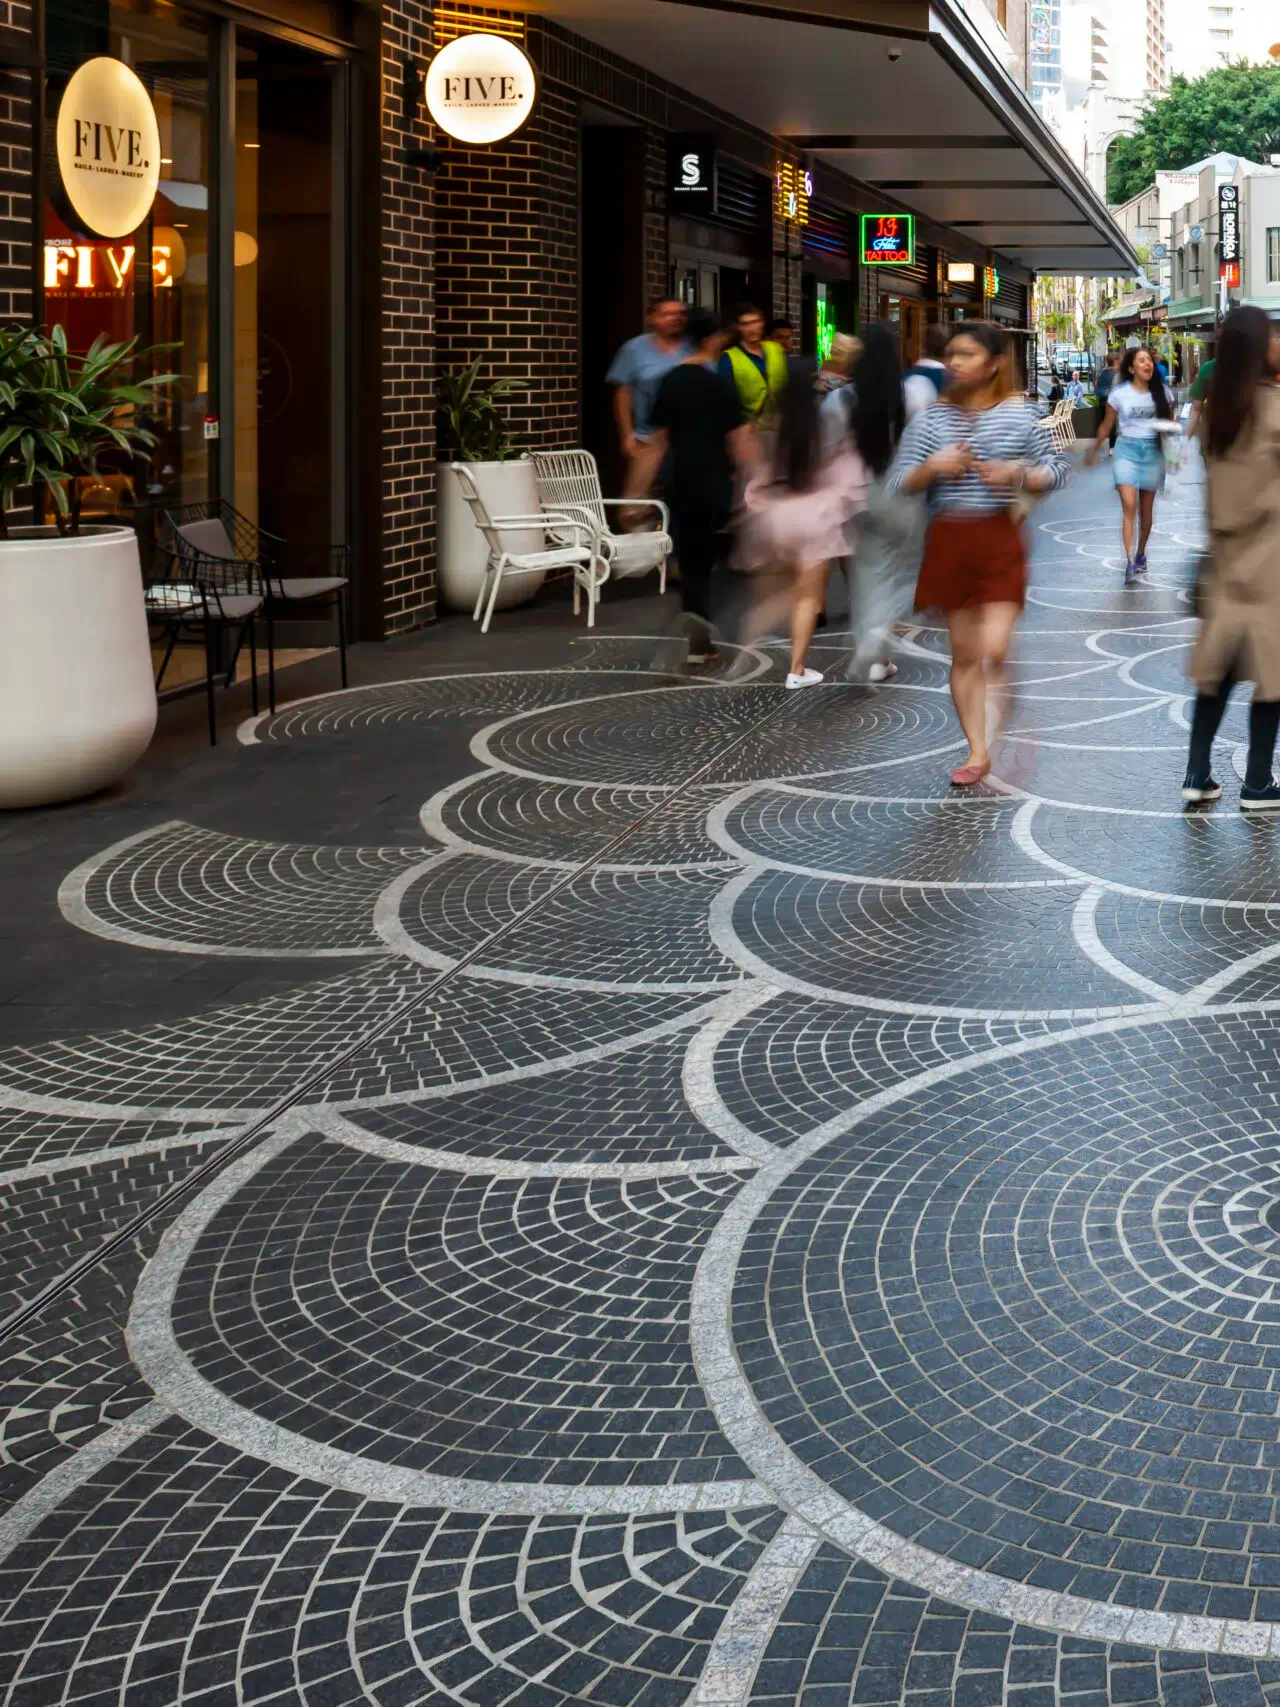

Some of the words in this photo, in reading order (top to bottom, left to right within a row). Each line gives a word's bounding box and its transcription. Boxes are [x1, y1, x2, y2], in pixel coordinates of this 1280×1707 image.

[444, 76, 524, 101] FIVE.
[73, 119, 150, 169] FIVE.
[877, 216, 899, 237] 13
[865, 250, 909, 261] TATTOO
